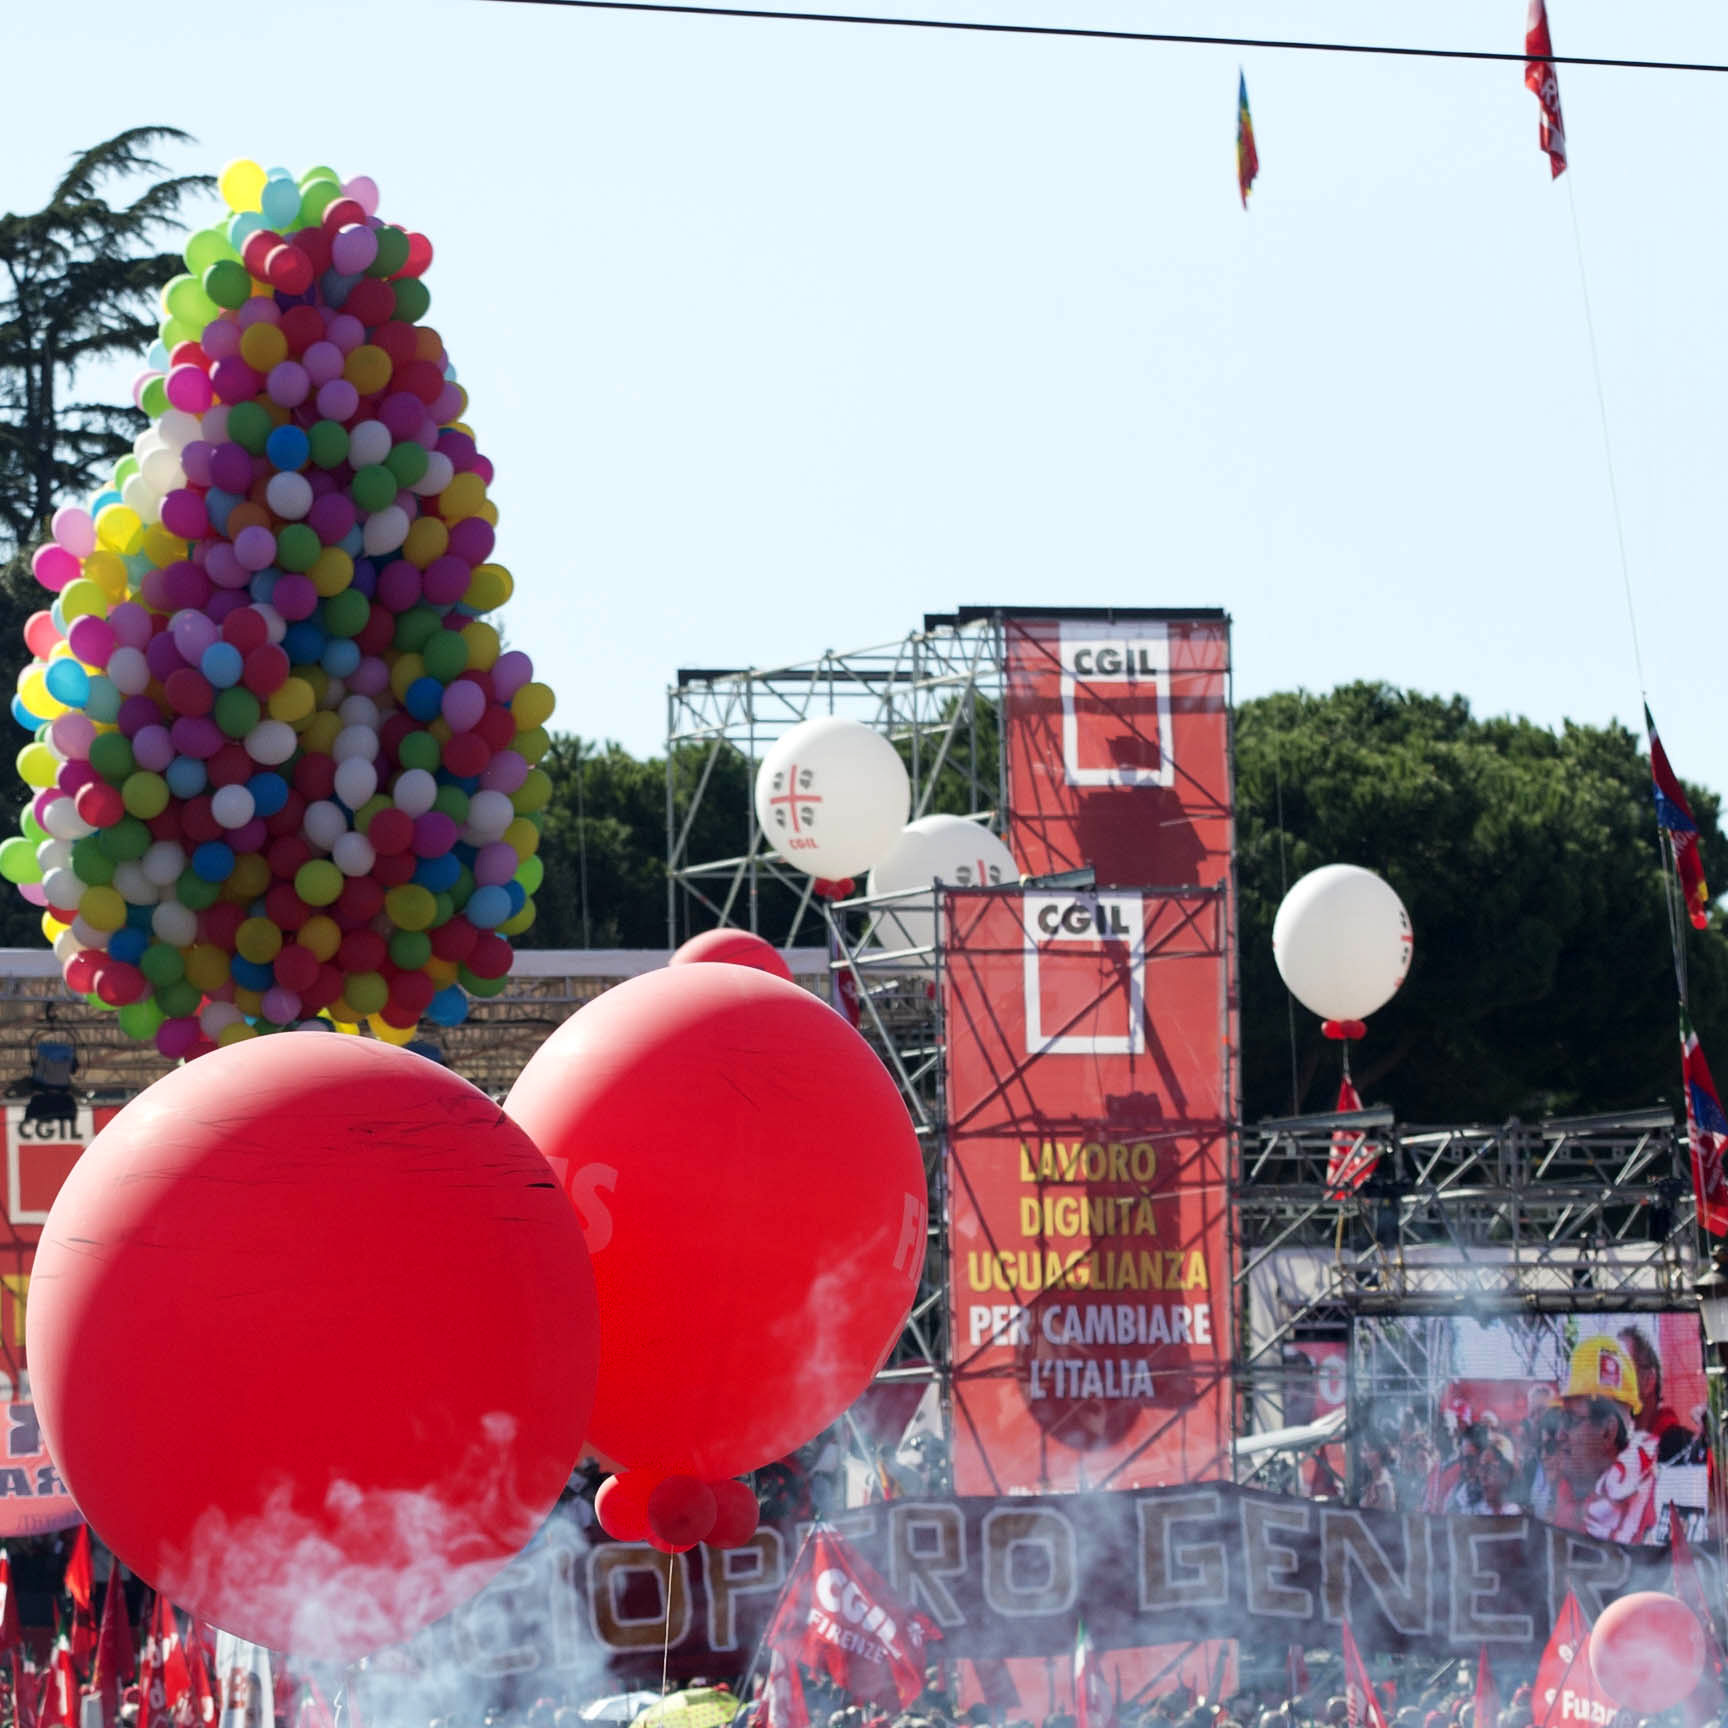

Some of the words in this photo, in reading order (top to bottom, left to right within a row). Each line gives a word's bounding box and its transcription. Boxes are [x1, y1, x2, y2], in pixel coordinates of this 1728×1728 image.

[1073, 648, 1157, 678] CGIL
[1036, 903, 1130, 936] CGIL
[1019, 1141, 1157, 1184] LAVORO
[1019, 1190, 1157, 1238] DIGNITÀ
[968, 1250, 1210, 1292] UGUAGLIANZA
[969, 1304, 1031, 1346] PER
[1041, 1303, 1212, 1346] CAMBIARE
[1029, 1358, 1155, 1400] L'ITALIA
